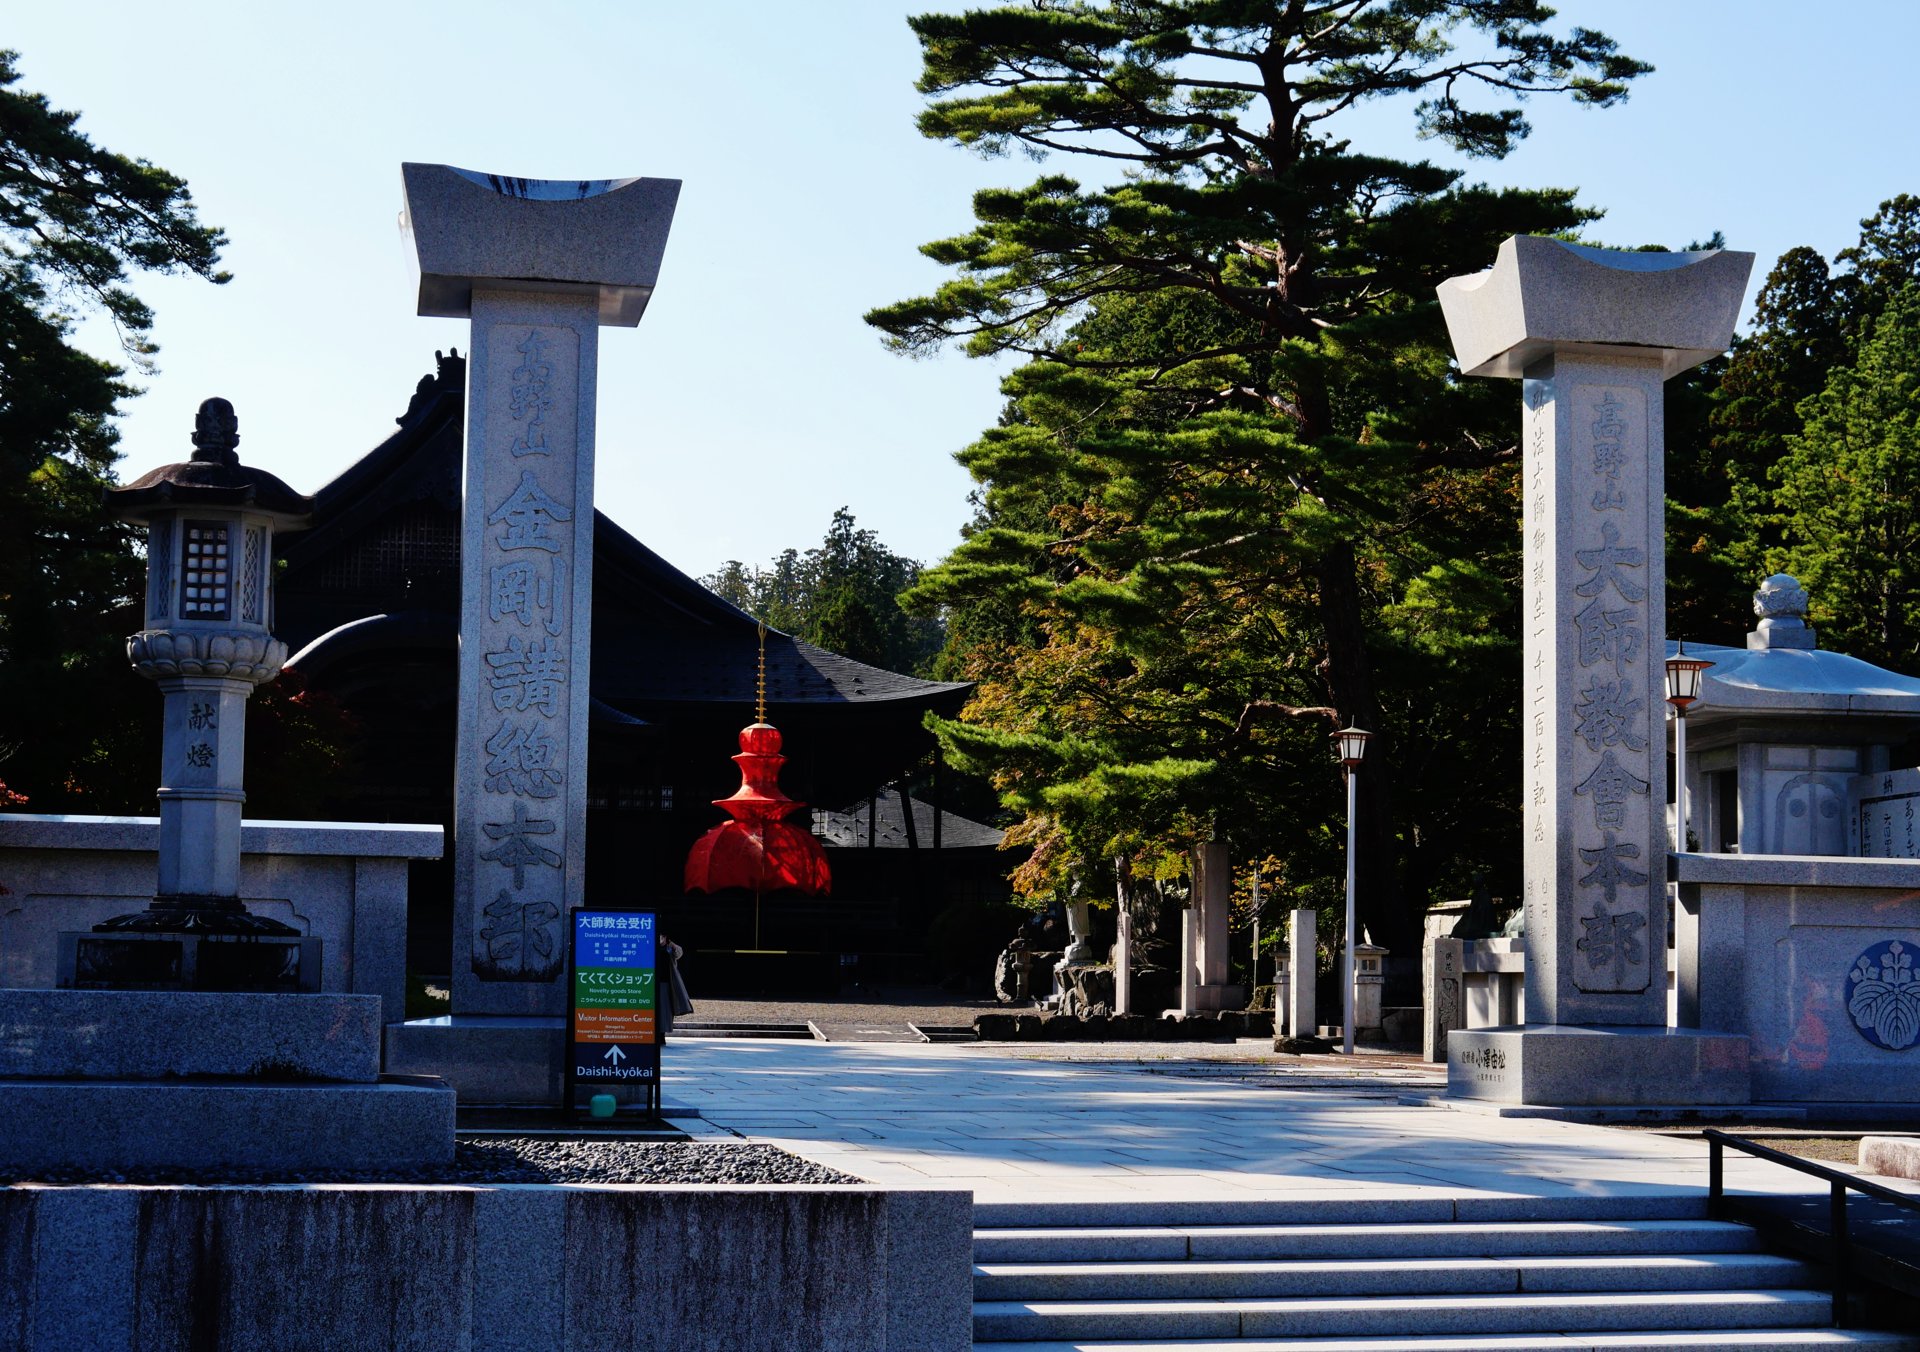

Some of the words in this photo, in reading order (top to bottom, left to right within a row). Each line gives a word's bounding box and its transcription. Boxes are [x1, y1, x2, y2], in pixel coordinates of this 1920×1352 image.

[579, 916, 652, 930] 大師教会受付
[578, 972, 653, 985] てくてくショップ
[578, 1013, 597, 1021] Visitor
[599, 1014, 632, 1022] Information
[633, 1014, 653, 1022] Center
[577, 1066, 653, 1079] Daishi-kyôkai
